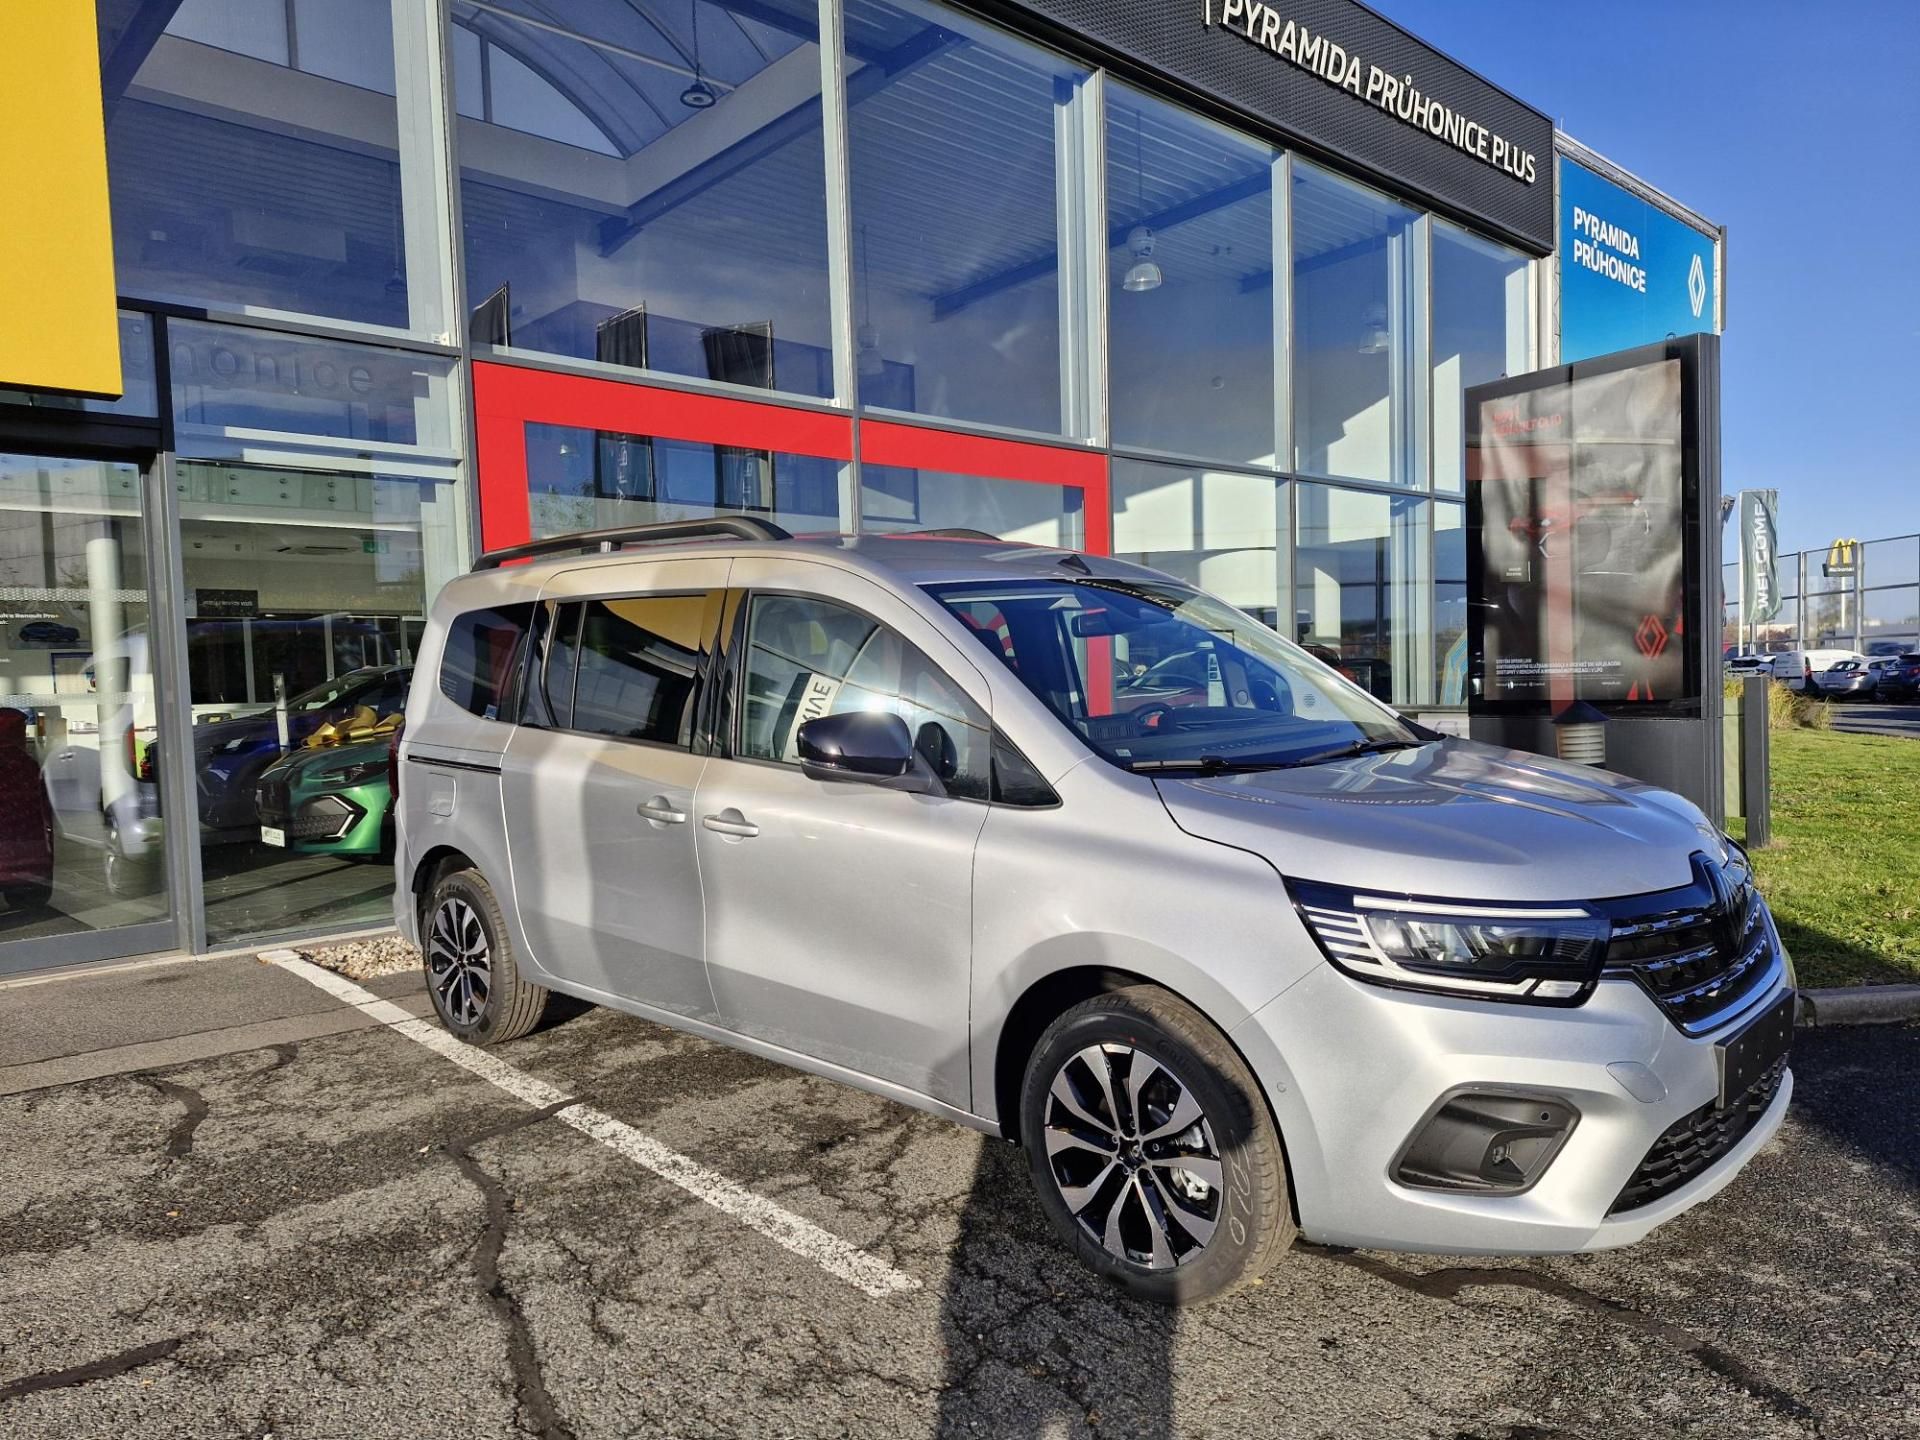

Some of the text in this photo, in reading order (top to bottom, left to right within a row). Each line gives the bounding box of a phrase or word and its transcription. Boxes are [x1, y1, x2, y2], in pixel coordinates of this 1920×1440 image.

[1222, 0, 1536, 184] PYRAMIDA PRŮHONICE PLUS
[1573, 206, 1640, 260] PYRAMIDA
[1573, 238, 1646, 293] PRŮHONICE
